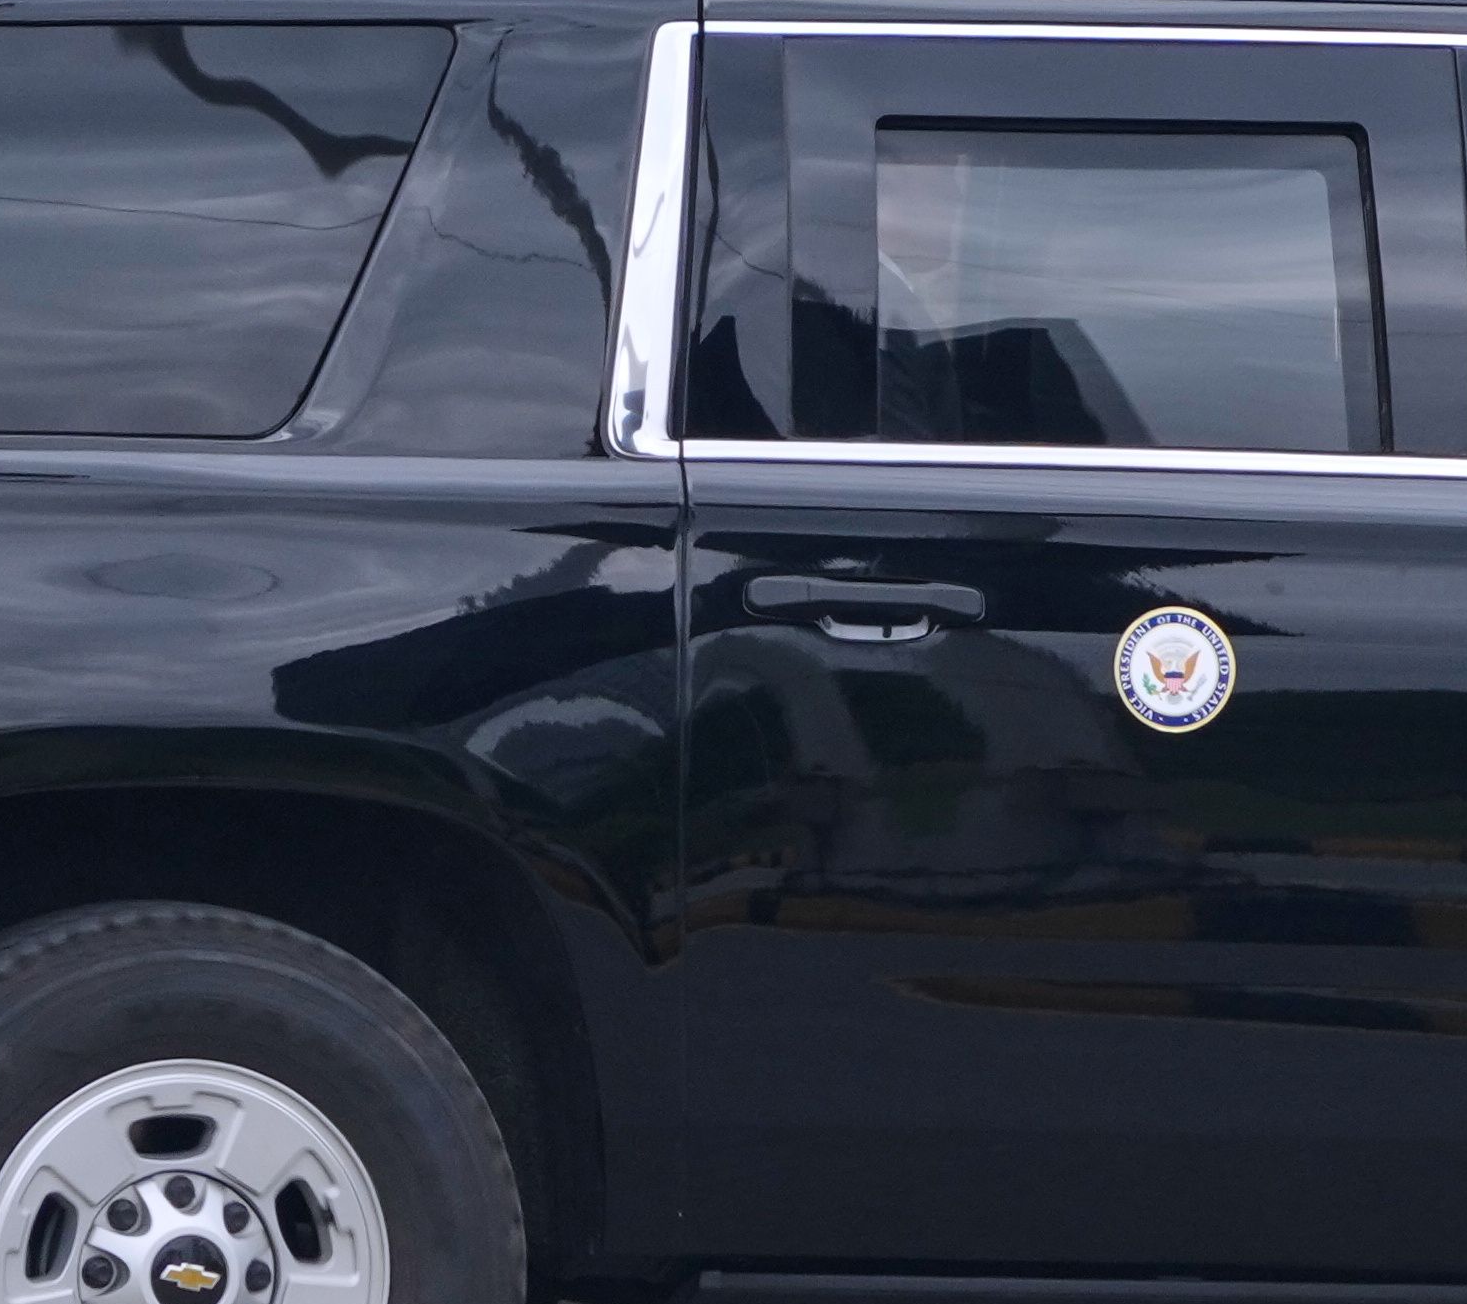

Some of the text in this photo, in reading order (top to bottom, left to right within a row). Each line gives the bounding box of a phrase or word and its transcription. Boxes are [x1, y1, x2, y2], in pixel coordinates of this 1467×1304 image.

[1119, 614, 1230, 722] VICE PRESIDENT OF THE UNITED STATES
